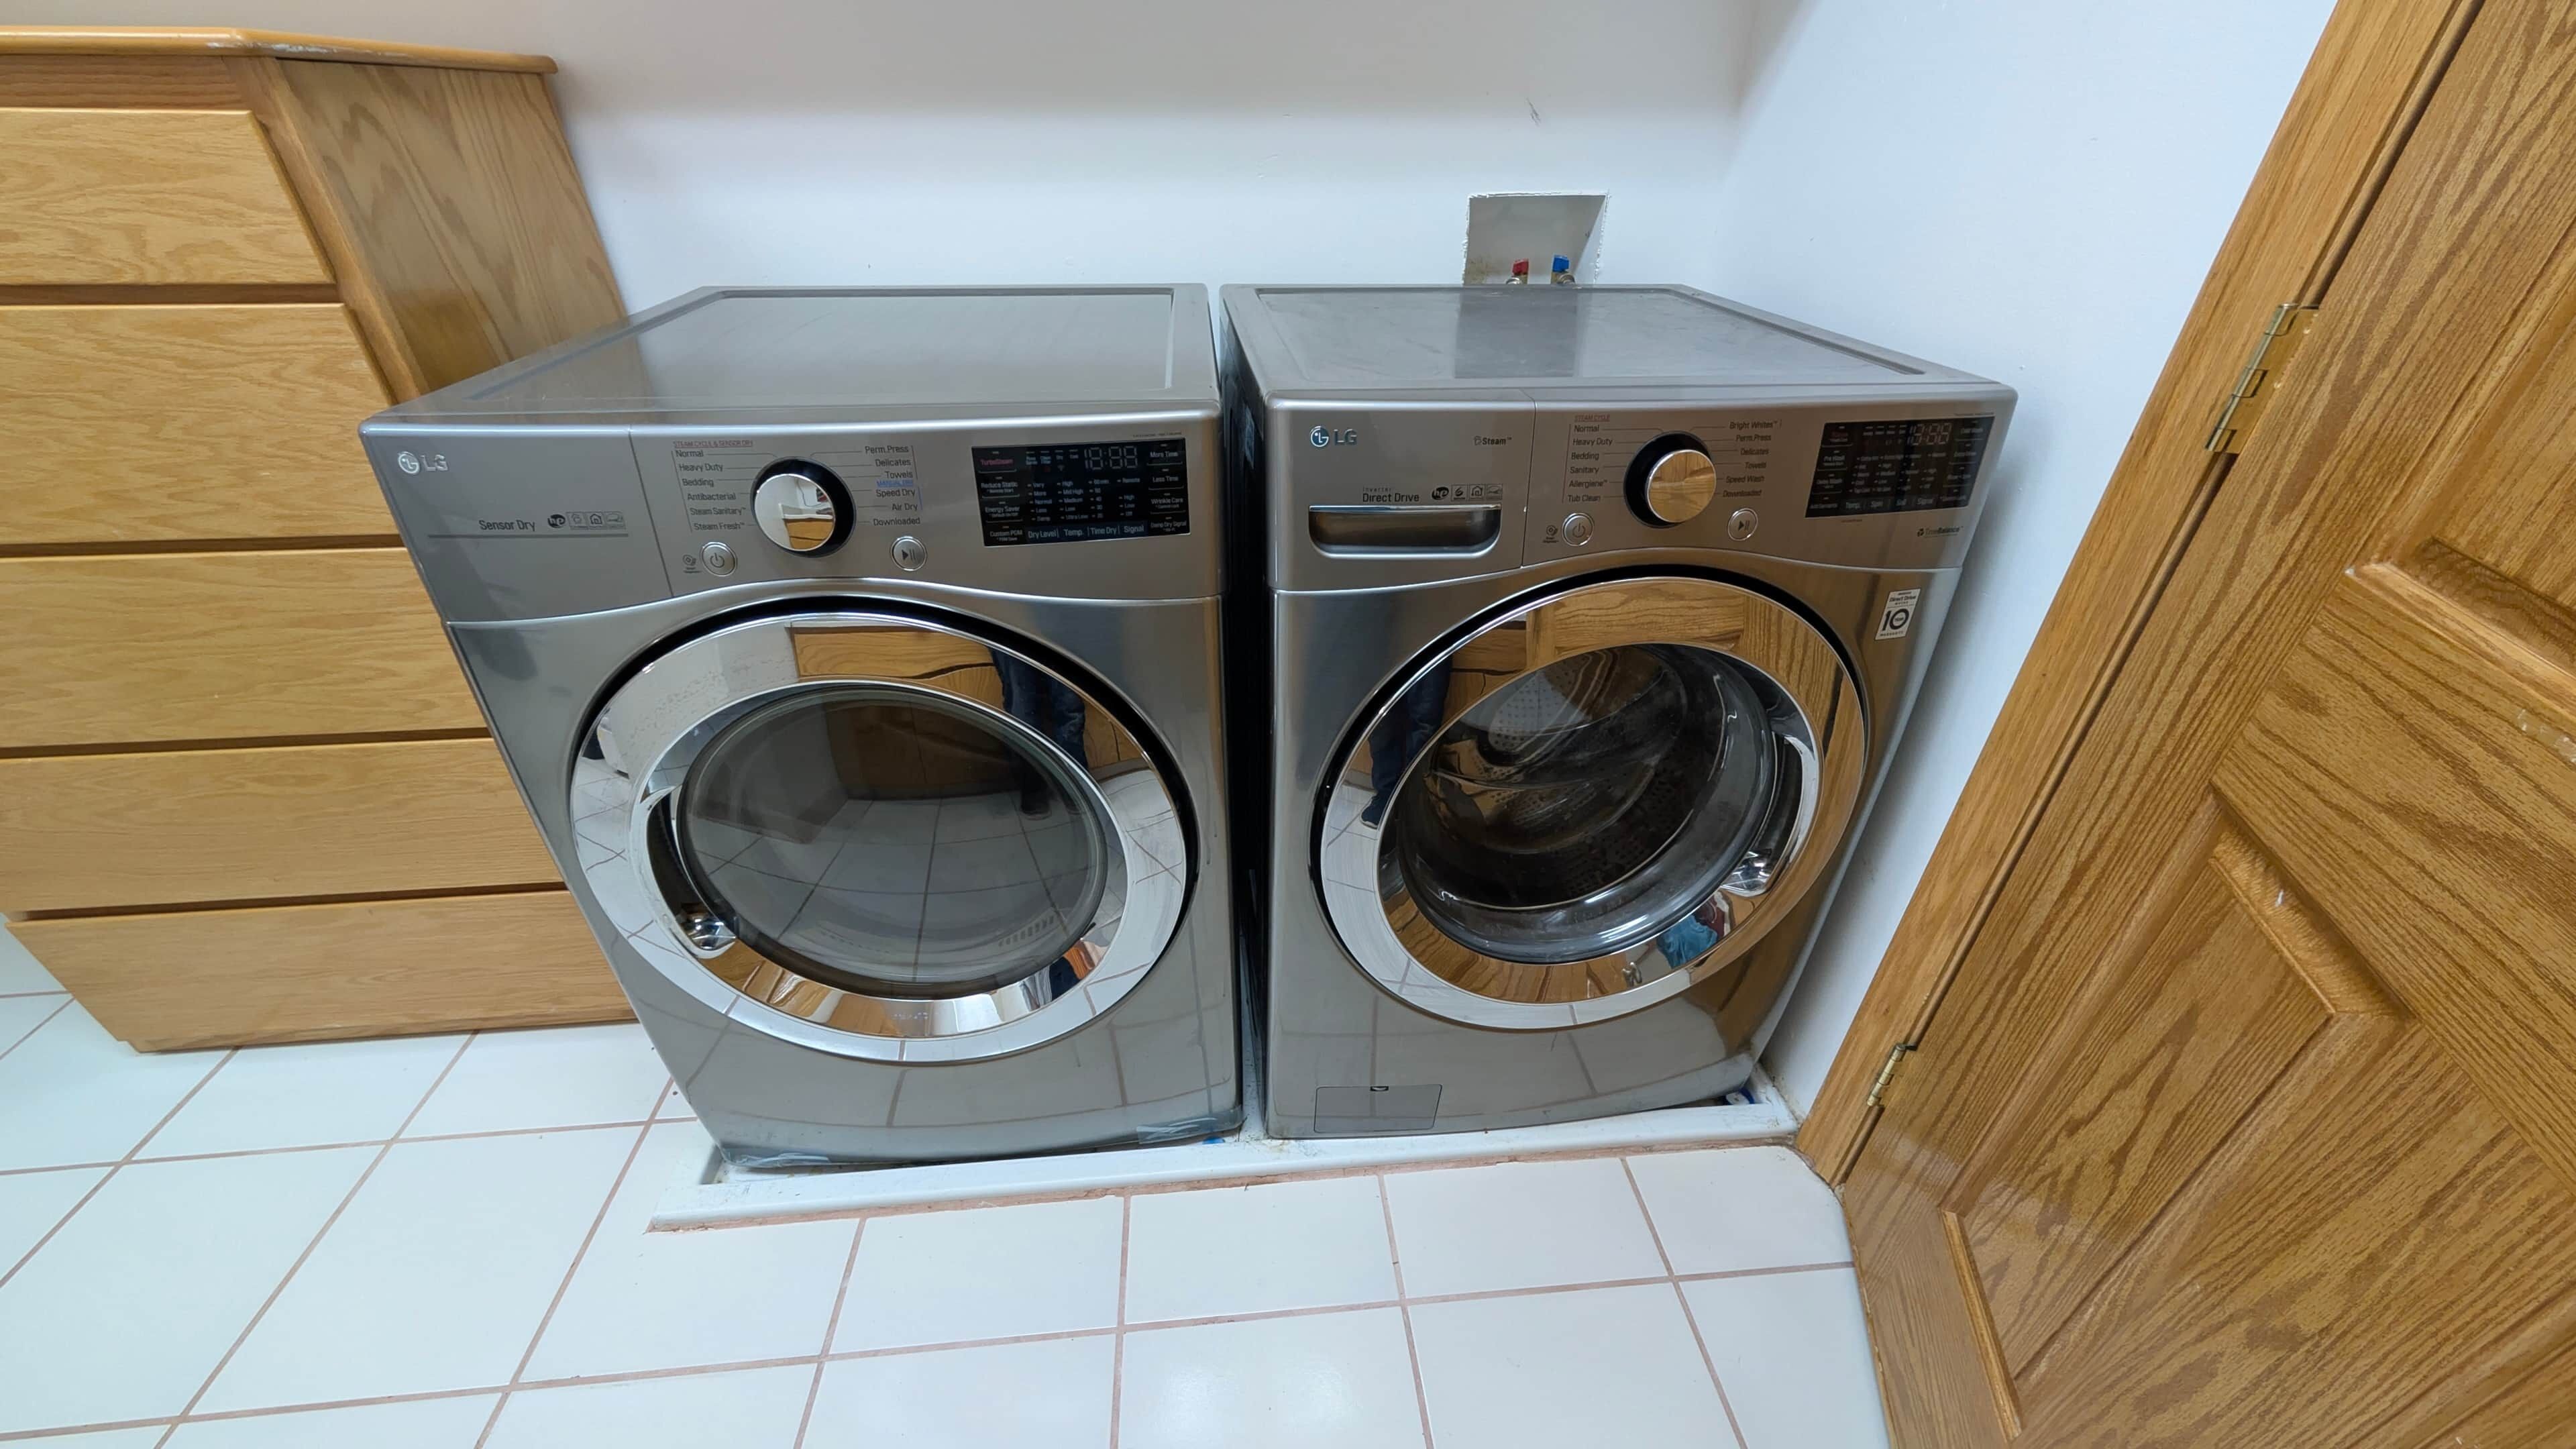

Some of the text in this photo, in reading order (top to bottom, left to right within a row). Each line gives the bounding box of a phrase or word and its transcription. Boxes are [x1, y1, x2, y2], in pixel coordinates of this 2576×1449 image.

[1574, 425, 1600, 433] Normal
[1729, 421, 1750, 431] Bright
[1334, 429, 1358, 446] LG
[1572, 437, 1613, 446] Heavy Duty
[886, 445, 909, 453] Press
[1571, 452, 1600, 460] Bedding
[420, 454, 448, 472] LG
[679, 463, 723, 472] Heavy Duty
[875, 459, 912, 467] Delicates
[1570, 466, 1599, 474] Sanitary
[682, 478, 714, 487] Bedding
[1726, 475, 1765, 484] Speed Wash
[875, 488, 916, 498] Speed Dry
[1362, 492, 1419, 503] Direct Drive
[1723, 490, 1762, 498] Downloaded
[1567, 494, 1601, 502] Tub Clean
[904, 502, 918, 511] Dry
[478, 520, 536, 531] Sensor Dry
[873, 517, 920, 526] Downloaded
[694, 523, 718, 531] Steam
[1028, 531, 1039, 539] Dry
[1040, 530, 1057, 538] Level
[1106, 526, 1117, 535] Dry
[1124, 525, 1144, 534] Signal
[1882, 608, 1909, 631] 10
